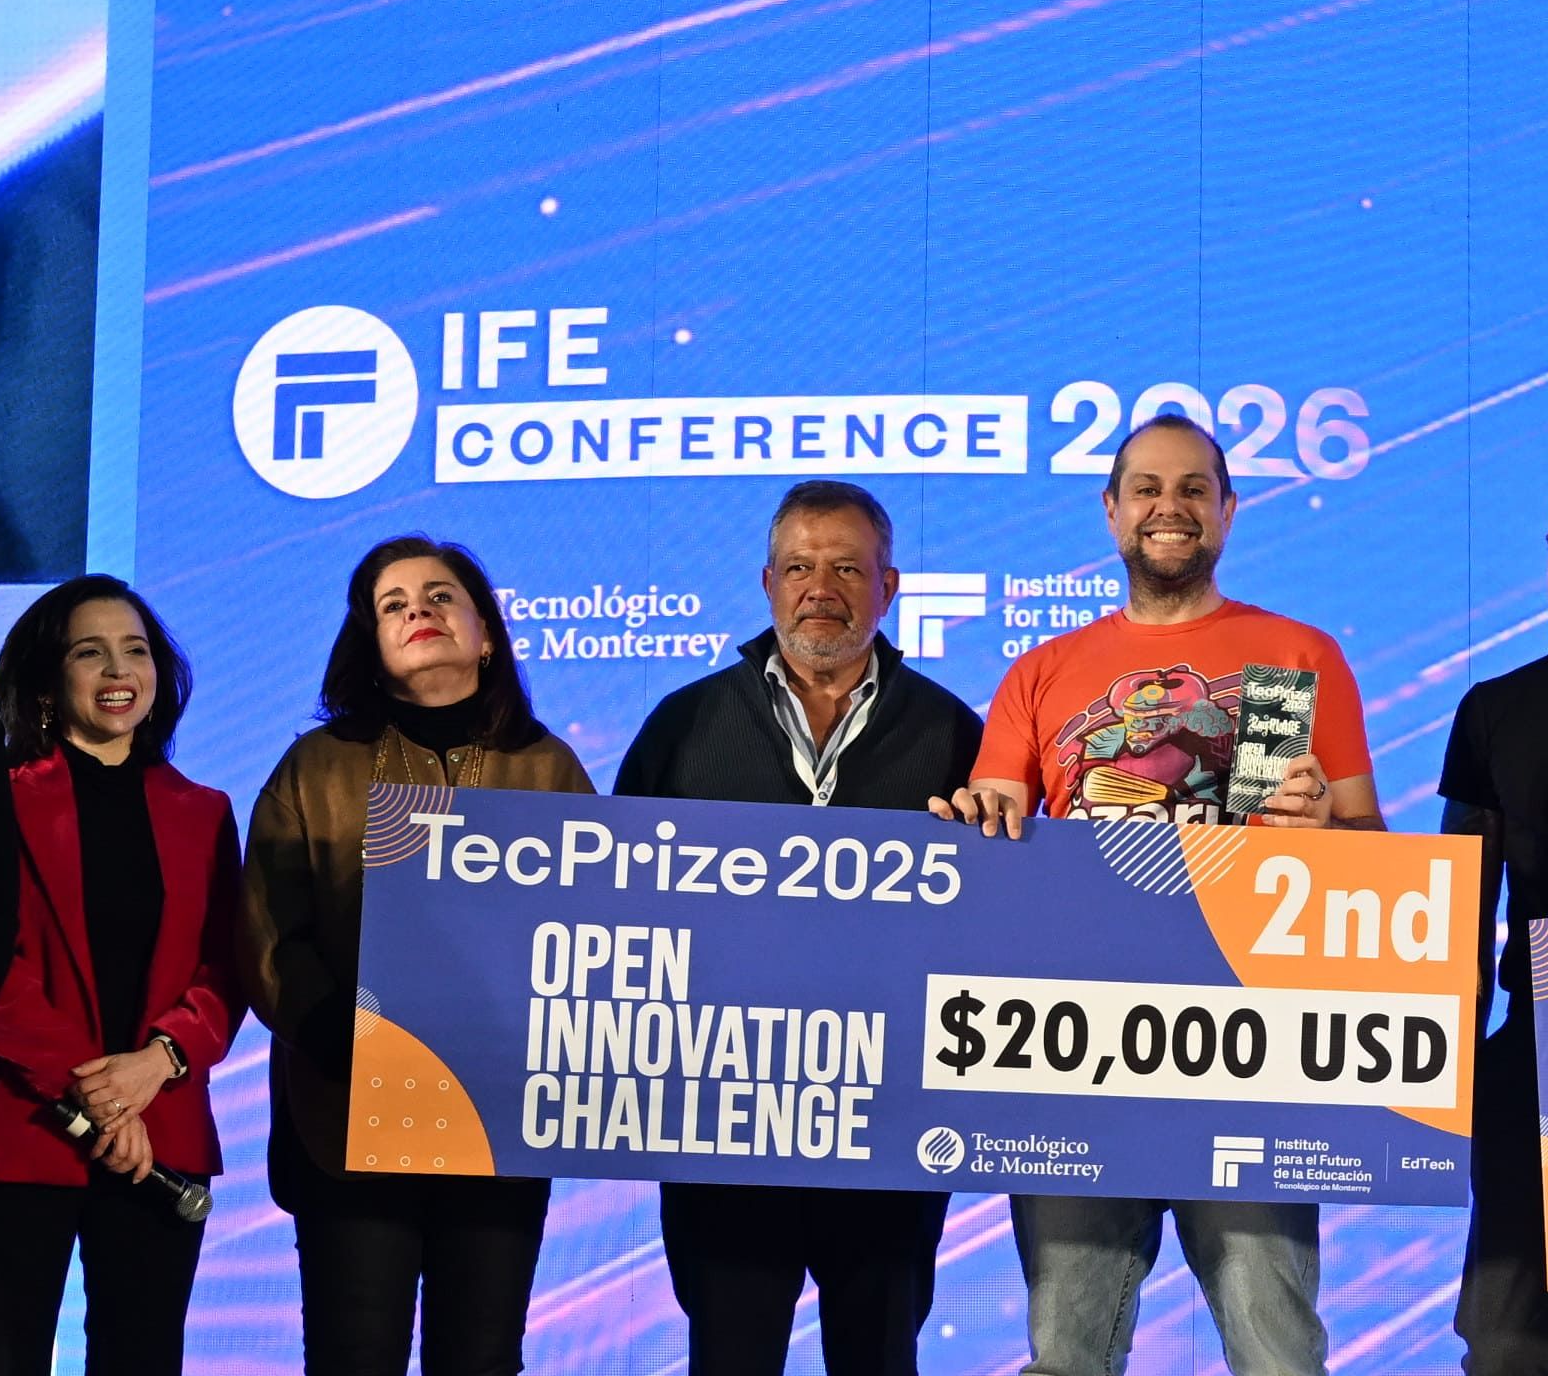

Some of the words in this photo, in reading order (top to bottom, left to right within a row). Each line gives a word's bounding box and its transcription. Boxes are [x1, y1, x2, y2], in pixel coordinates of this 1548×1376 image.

[441, 306, 608, 391] IFE
[451, 412, 1002, 468] CONFERENCE
[1003, 573, 1121, 598] Institute
[494, 584, 702, 628] Tecnológico
[1003, 604, 1043, 628] for
[1048, 604, 1094, 628] the
[512, 634, 531, 660] e
[539, 627, 731, 667] Monterrey
[1002, 634, 1032, 659] of
[409, 812, 769, 897] TecPrize
[776, 834, 963, 905] 2025
[1249, 854, 1453, 963] 2nd
[530, 921, 691, 1002] OPEN
[525, 996, 886, 1085] INNOVATION
[935, 989, 1268, 1086] $20,000
[1300, 1011, 1448, 1084] USD
[521, 1072, 875, 1161] CHALLENGE
[971, 1132, 1090, 1159] Tecnológico
[1274, 1137, 1329, 1152] Instituto
[1274, 1155, 1303, 1167] para
[1305, 1153, 1317, 1165] el
[1319, 1154, 1362, 1167] Futuro
[969, 1154, 997, 1174] de
[999, 1155, 1104, 1182] Monterrey
[1273, 1167, 1290, 1179] de
[1292, 1167, 1304, 1180] la
[1306, 1168, 1373, 1183] Educación
[1401, 1157, 1455, 1171] EdTech
[1273, 1181, 1319, 1192] Tecnológico
[1321, 1182, 1331, 1191] de
[1331, 1183, 1372, 1193] Monterrey
